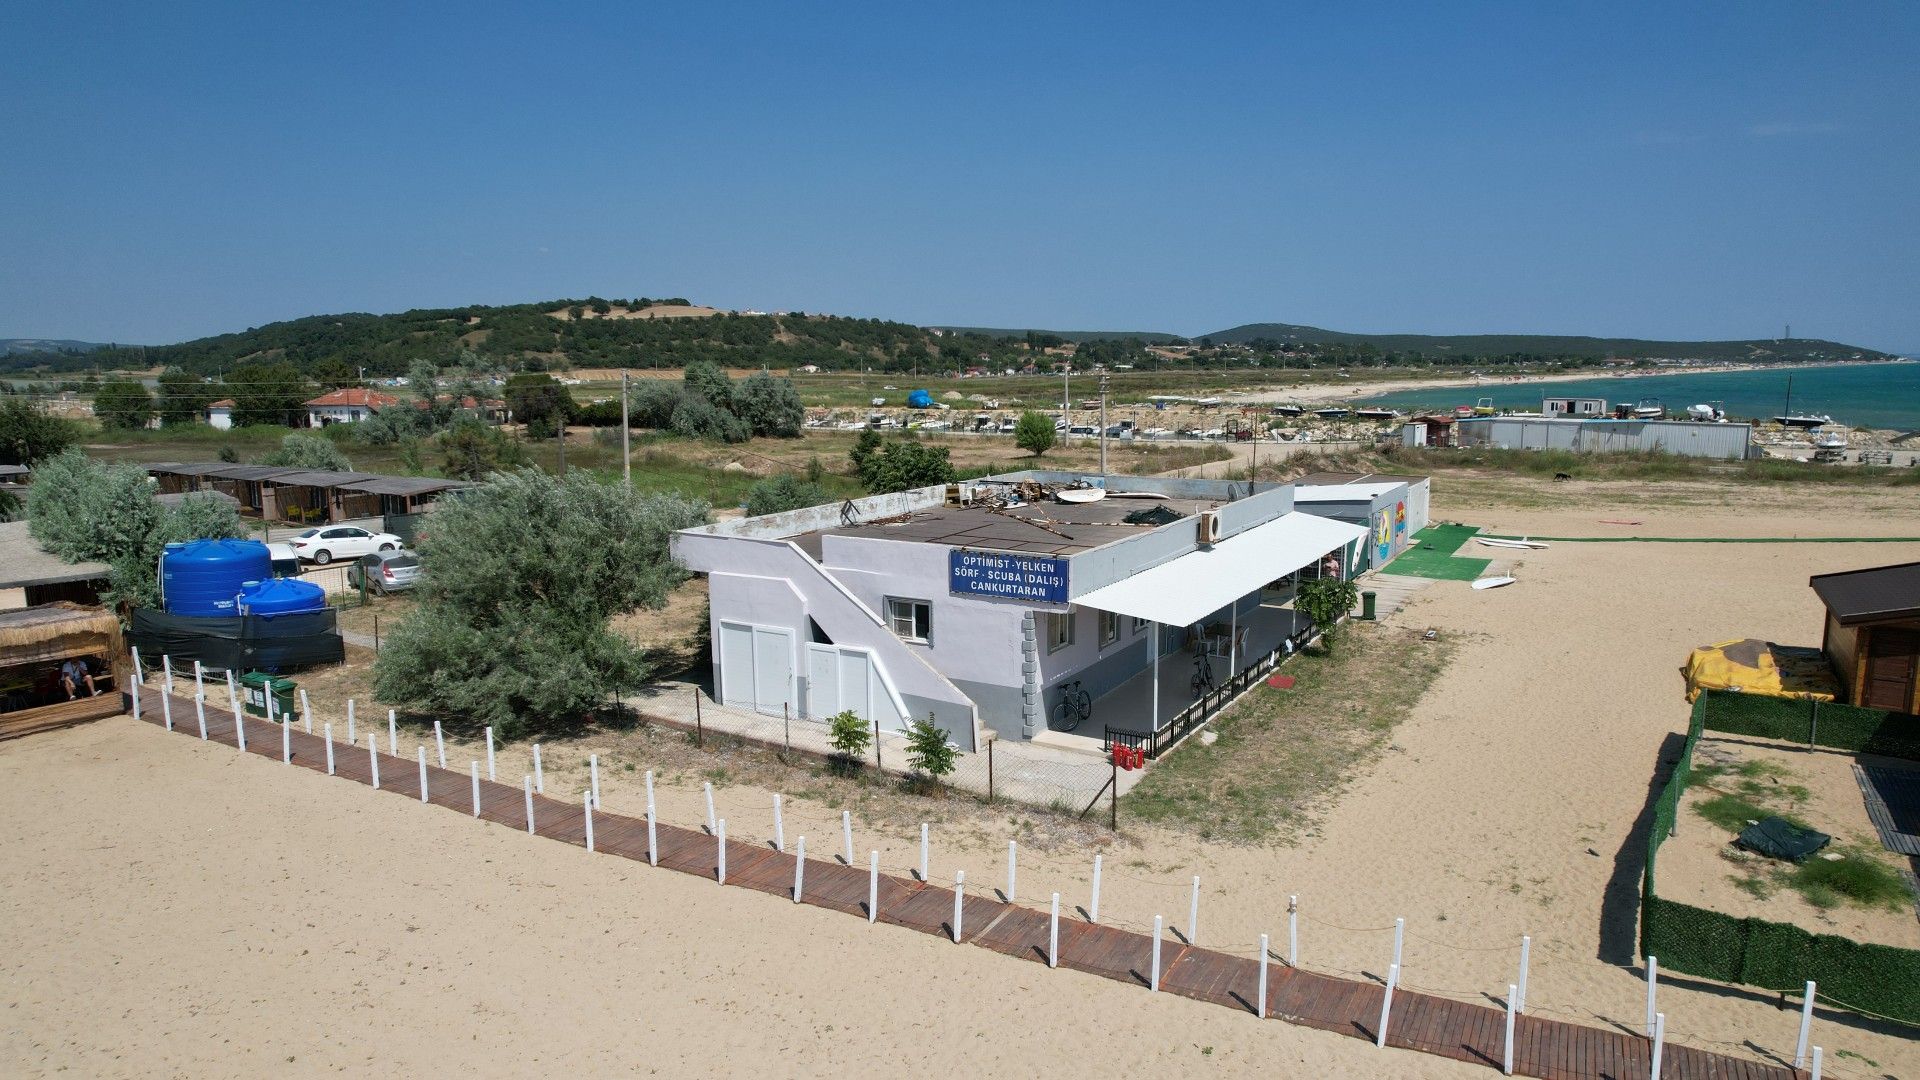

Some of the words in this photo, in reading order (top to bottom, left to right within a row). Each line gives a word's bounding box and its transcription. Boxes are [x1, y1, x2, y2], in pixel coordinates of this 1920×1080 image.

[963, 556, 1010, 569] OPTİMİST
[954, 566, 979, 578] SÖRF
[987, 570, 1022, 582] SCUBA
[1024, 574, 1064, 588] (DALIŞ)
[970, 581, 1046, 597] CANKURTARAN
